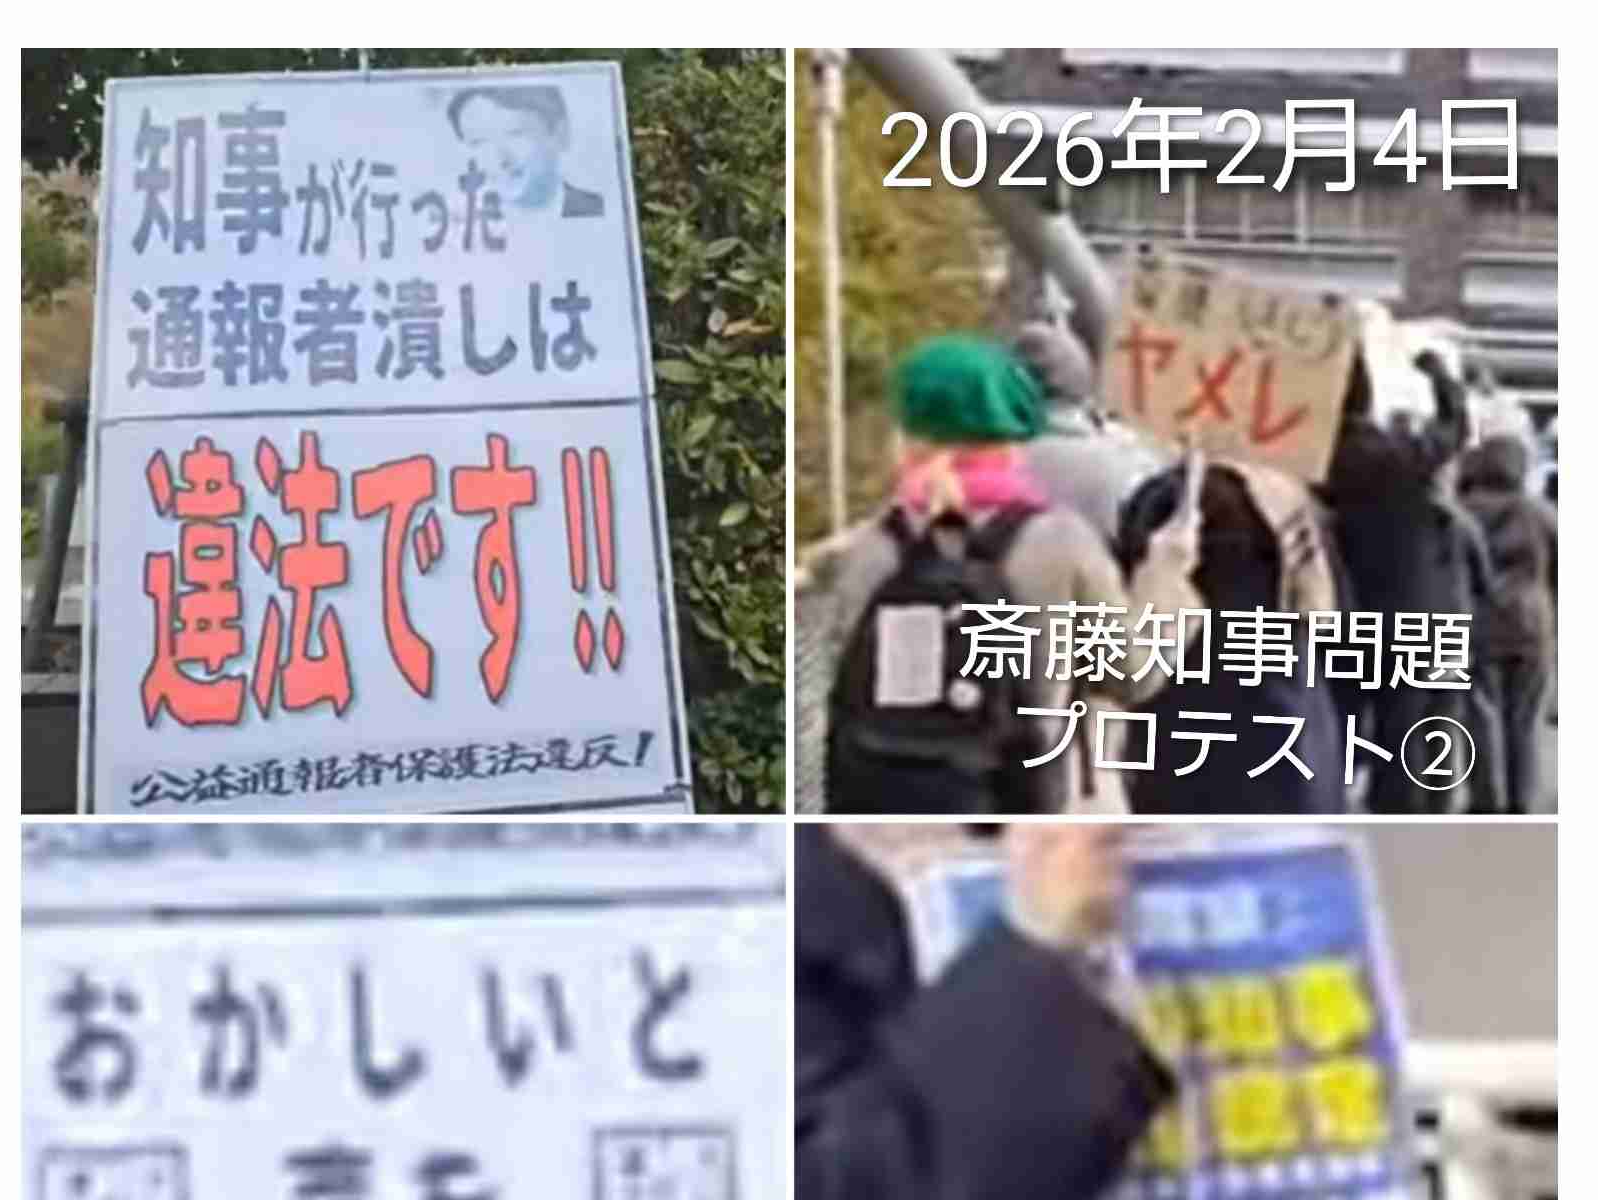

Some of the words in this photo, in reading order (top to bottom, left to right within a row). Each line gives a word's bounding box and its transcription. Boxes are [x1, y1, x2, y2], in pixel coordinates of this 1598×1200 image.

[130, 100, 506, 262] 知事が行った
[127, 280, 600, 391] 通報者潰しは
[140, 430, 626, 732] 違法です!!
[54, 945, 708, 1100] おかしいと
